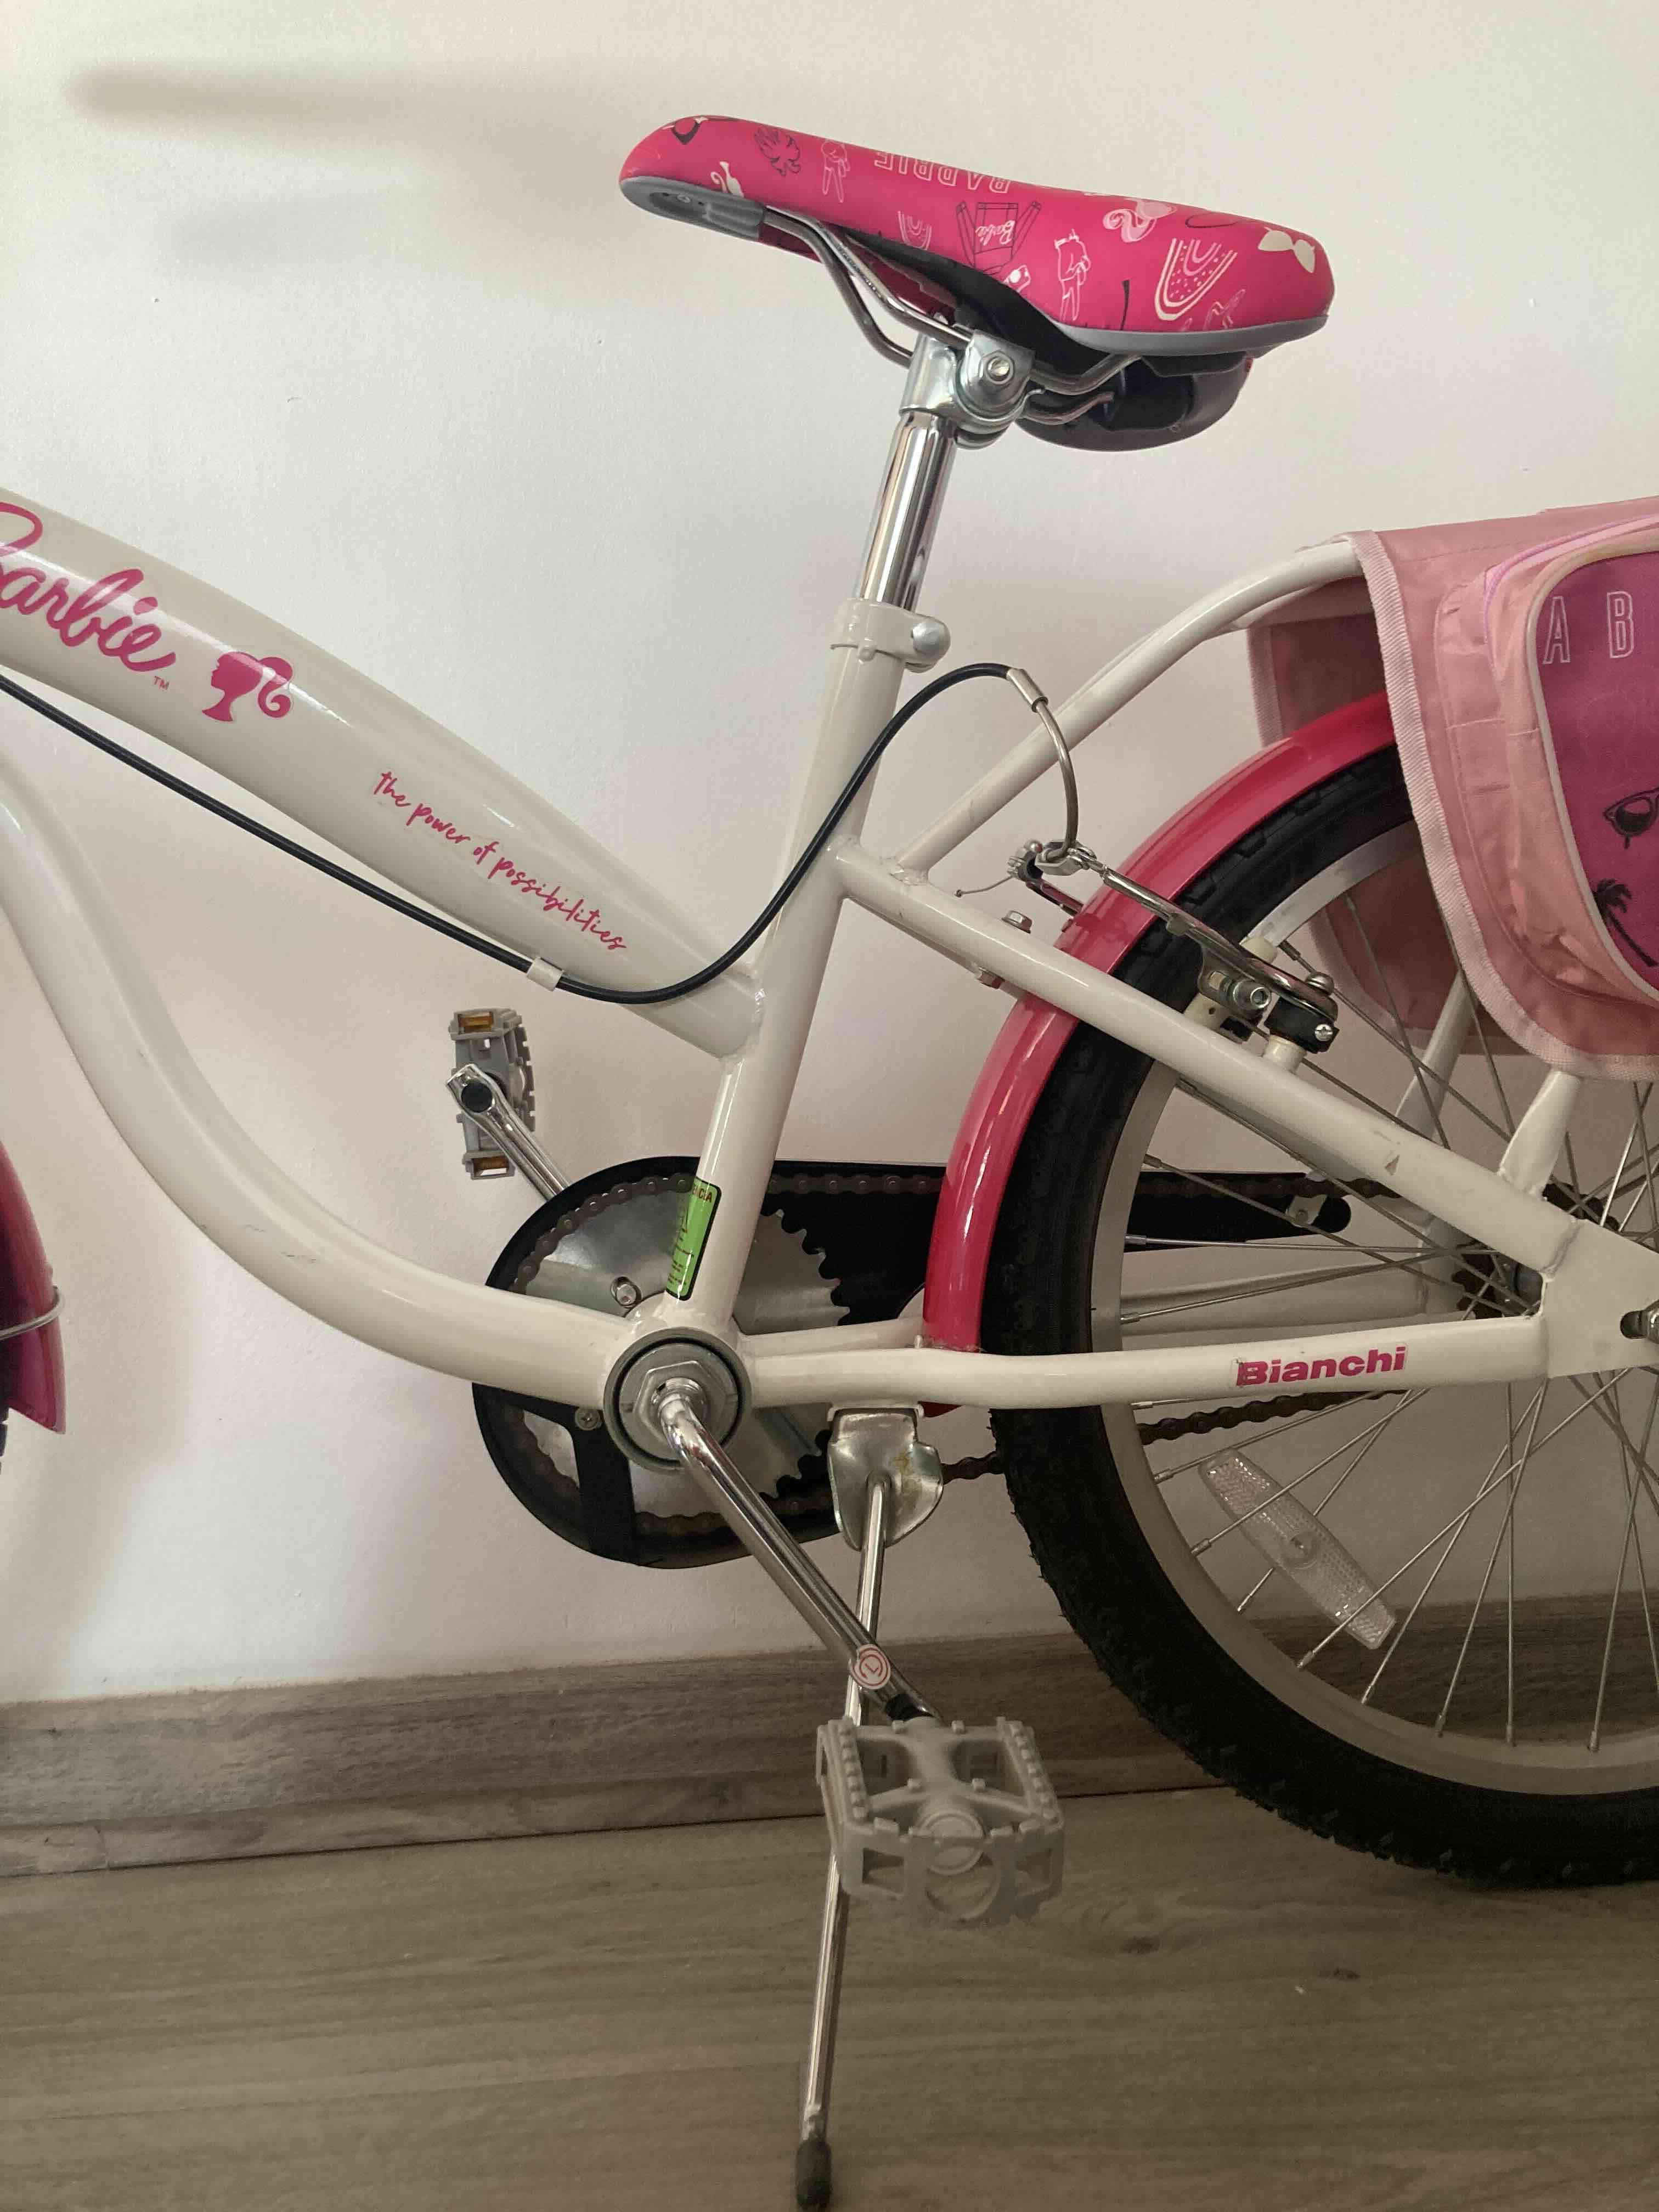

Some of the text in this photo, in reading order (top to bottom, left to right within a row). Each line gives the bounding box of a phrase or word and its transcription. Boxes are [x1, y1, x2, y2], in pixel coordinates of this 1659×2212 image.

[374, 771, 627, 950] the power of possibilities
[1236, 1346, 1406, 1386] Bianchi
